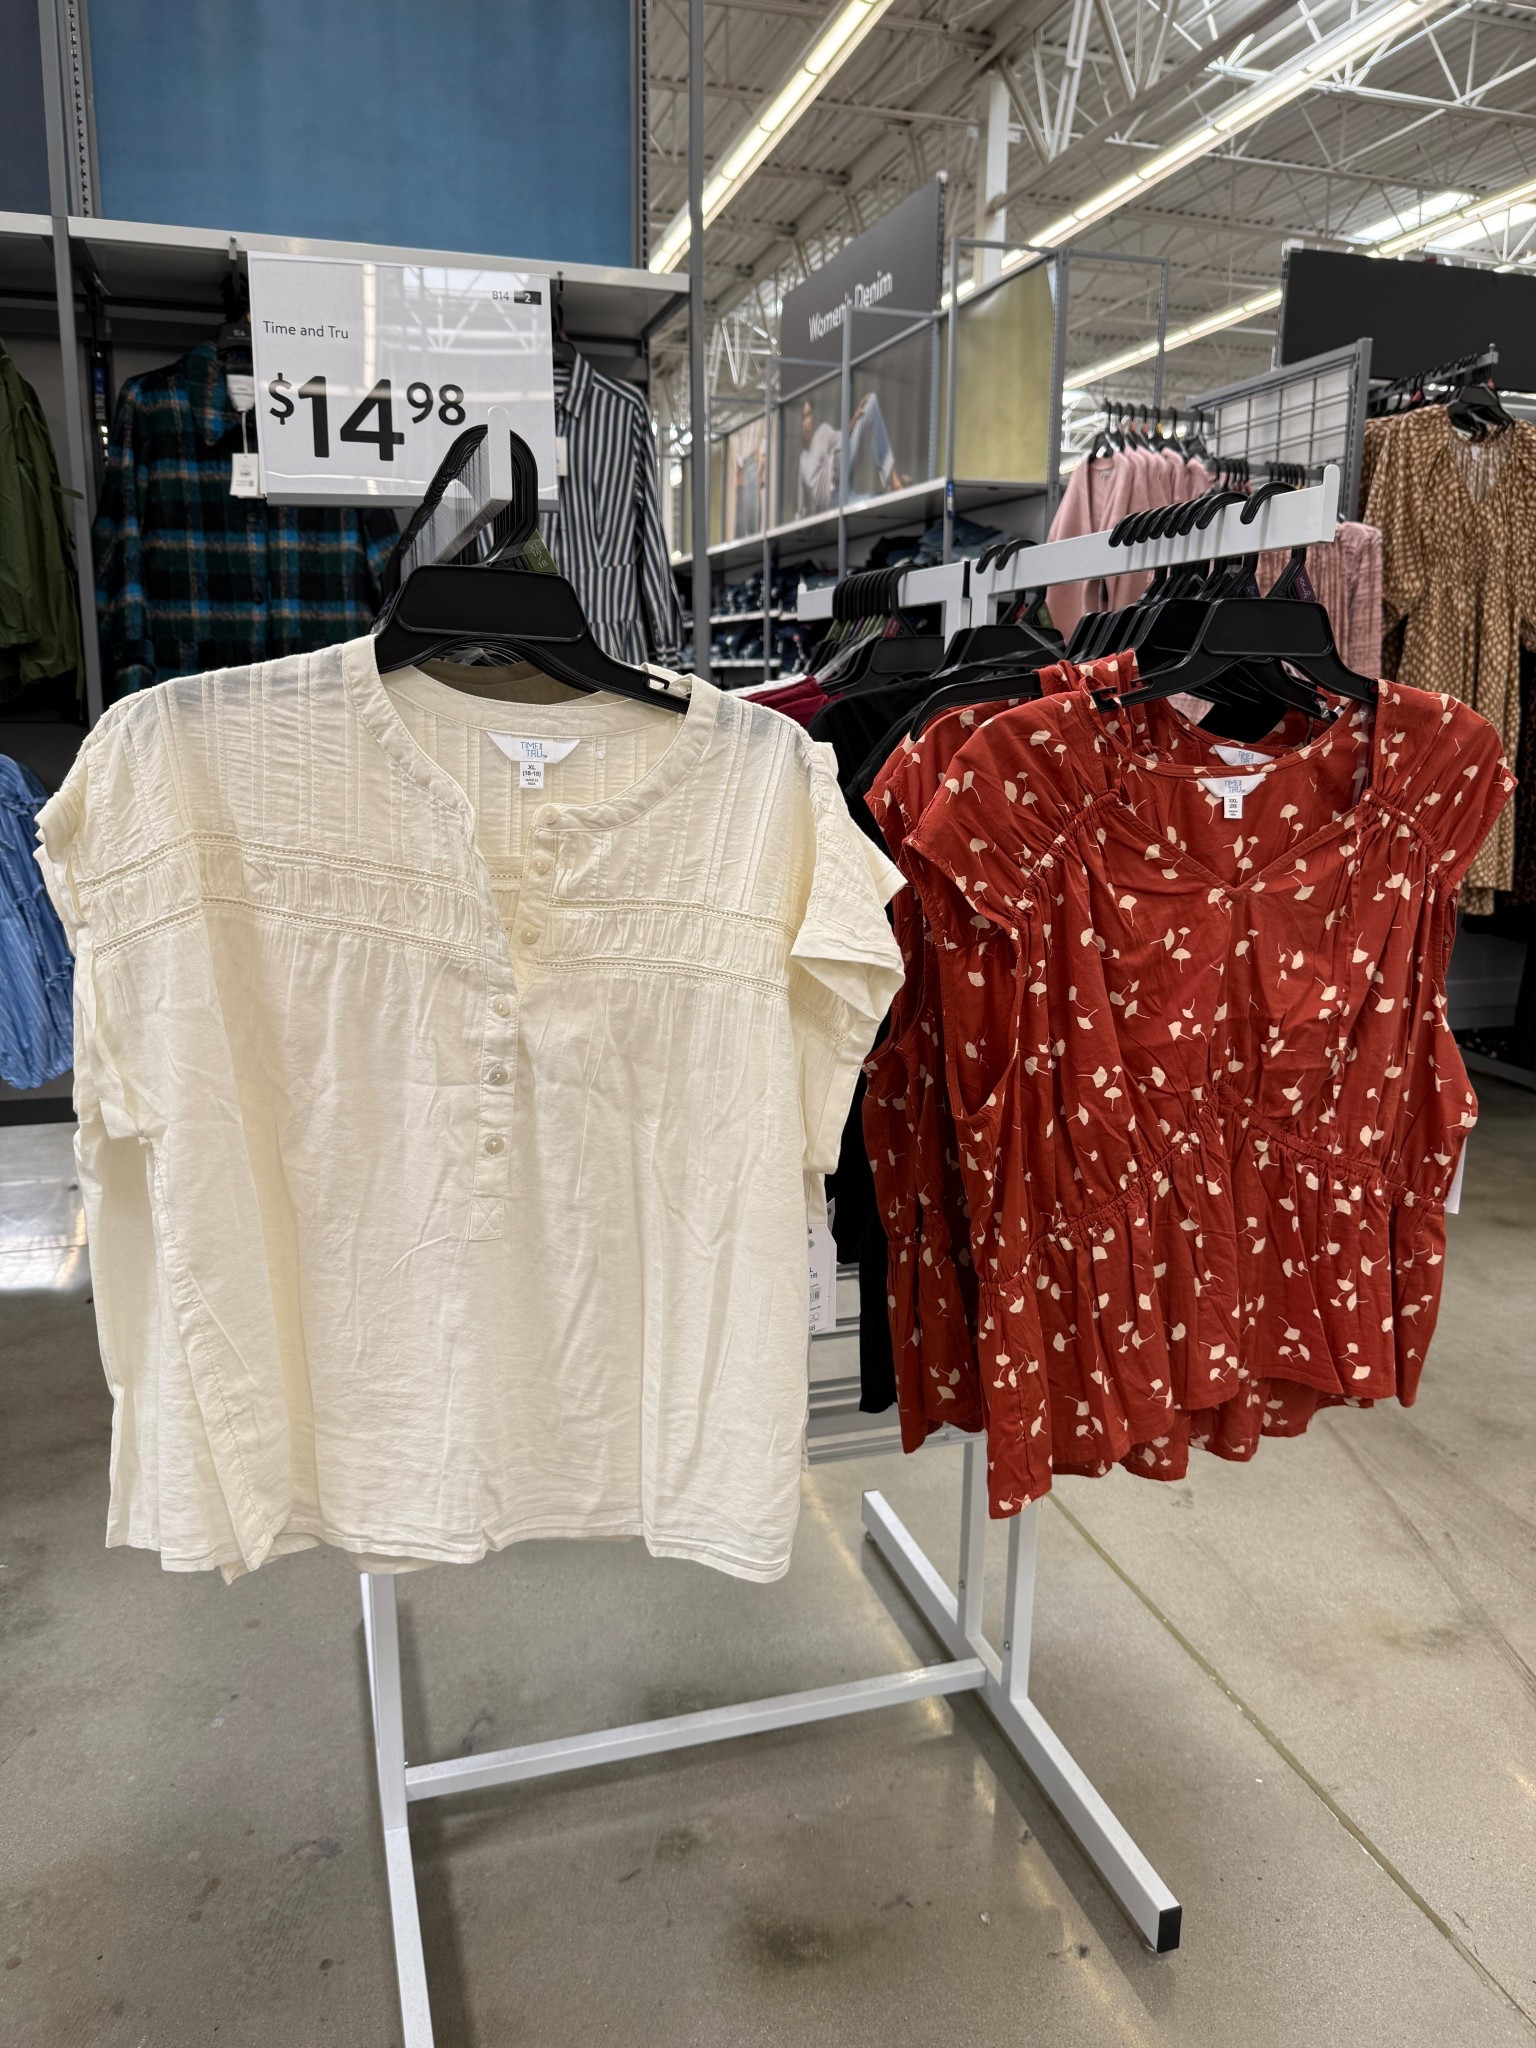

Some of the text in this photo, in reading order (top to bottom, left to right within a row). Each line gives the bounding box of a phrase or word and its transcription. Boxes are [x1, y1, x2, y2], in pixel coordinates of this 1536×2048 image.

[854, 270, 892, 308] Denim
[492, 290, 531, 302] B14 2
[262, 320, 296, 335] Time
[300, 325, 324, 337] and
[327, 325, 349, 339] Tru
[520, 742, 540, 750] TIME
[527, 750, 543, 758] TRU
